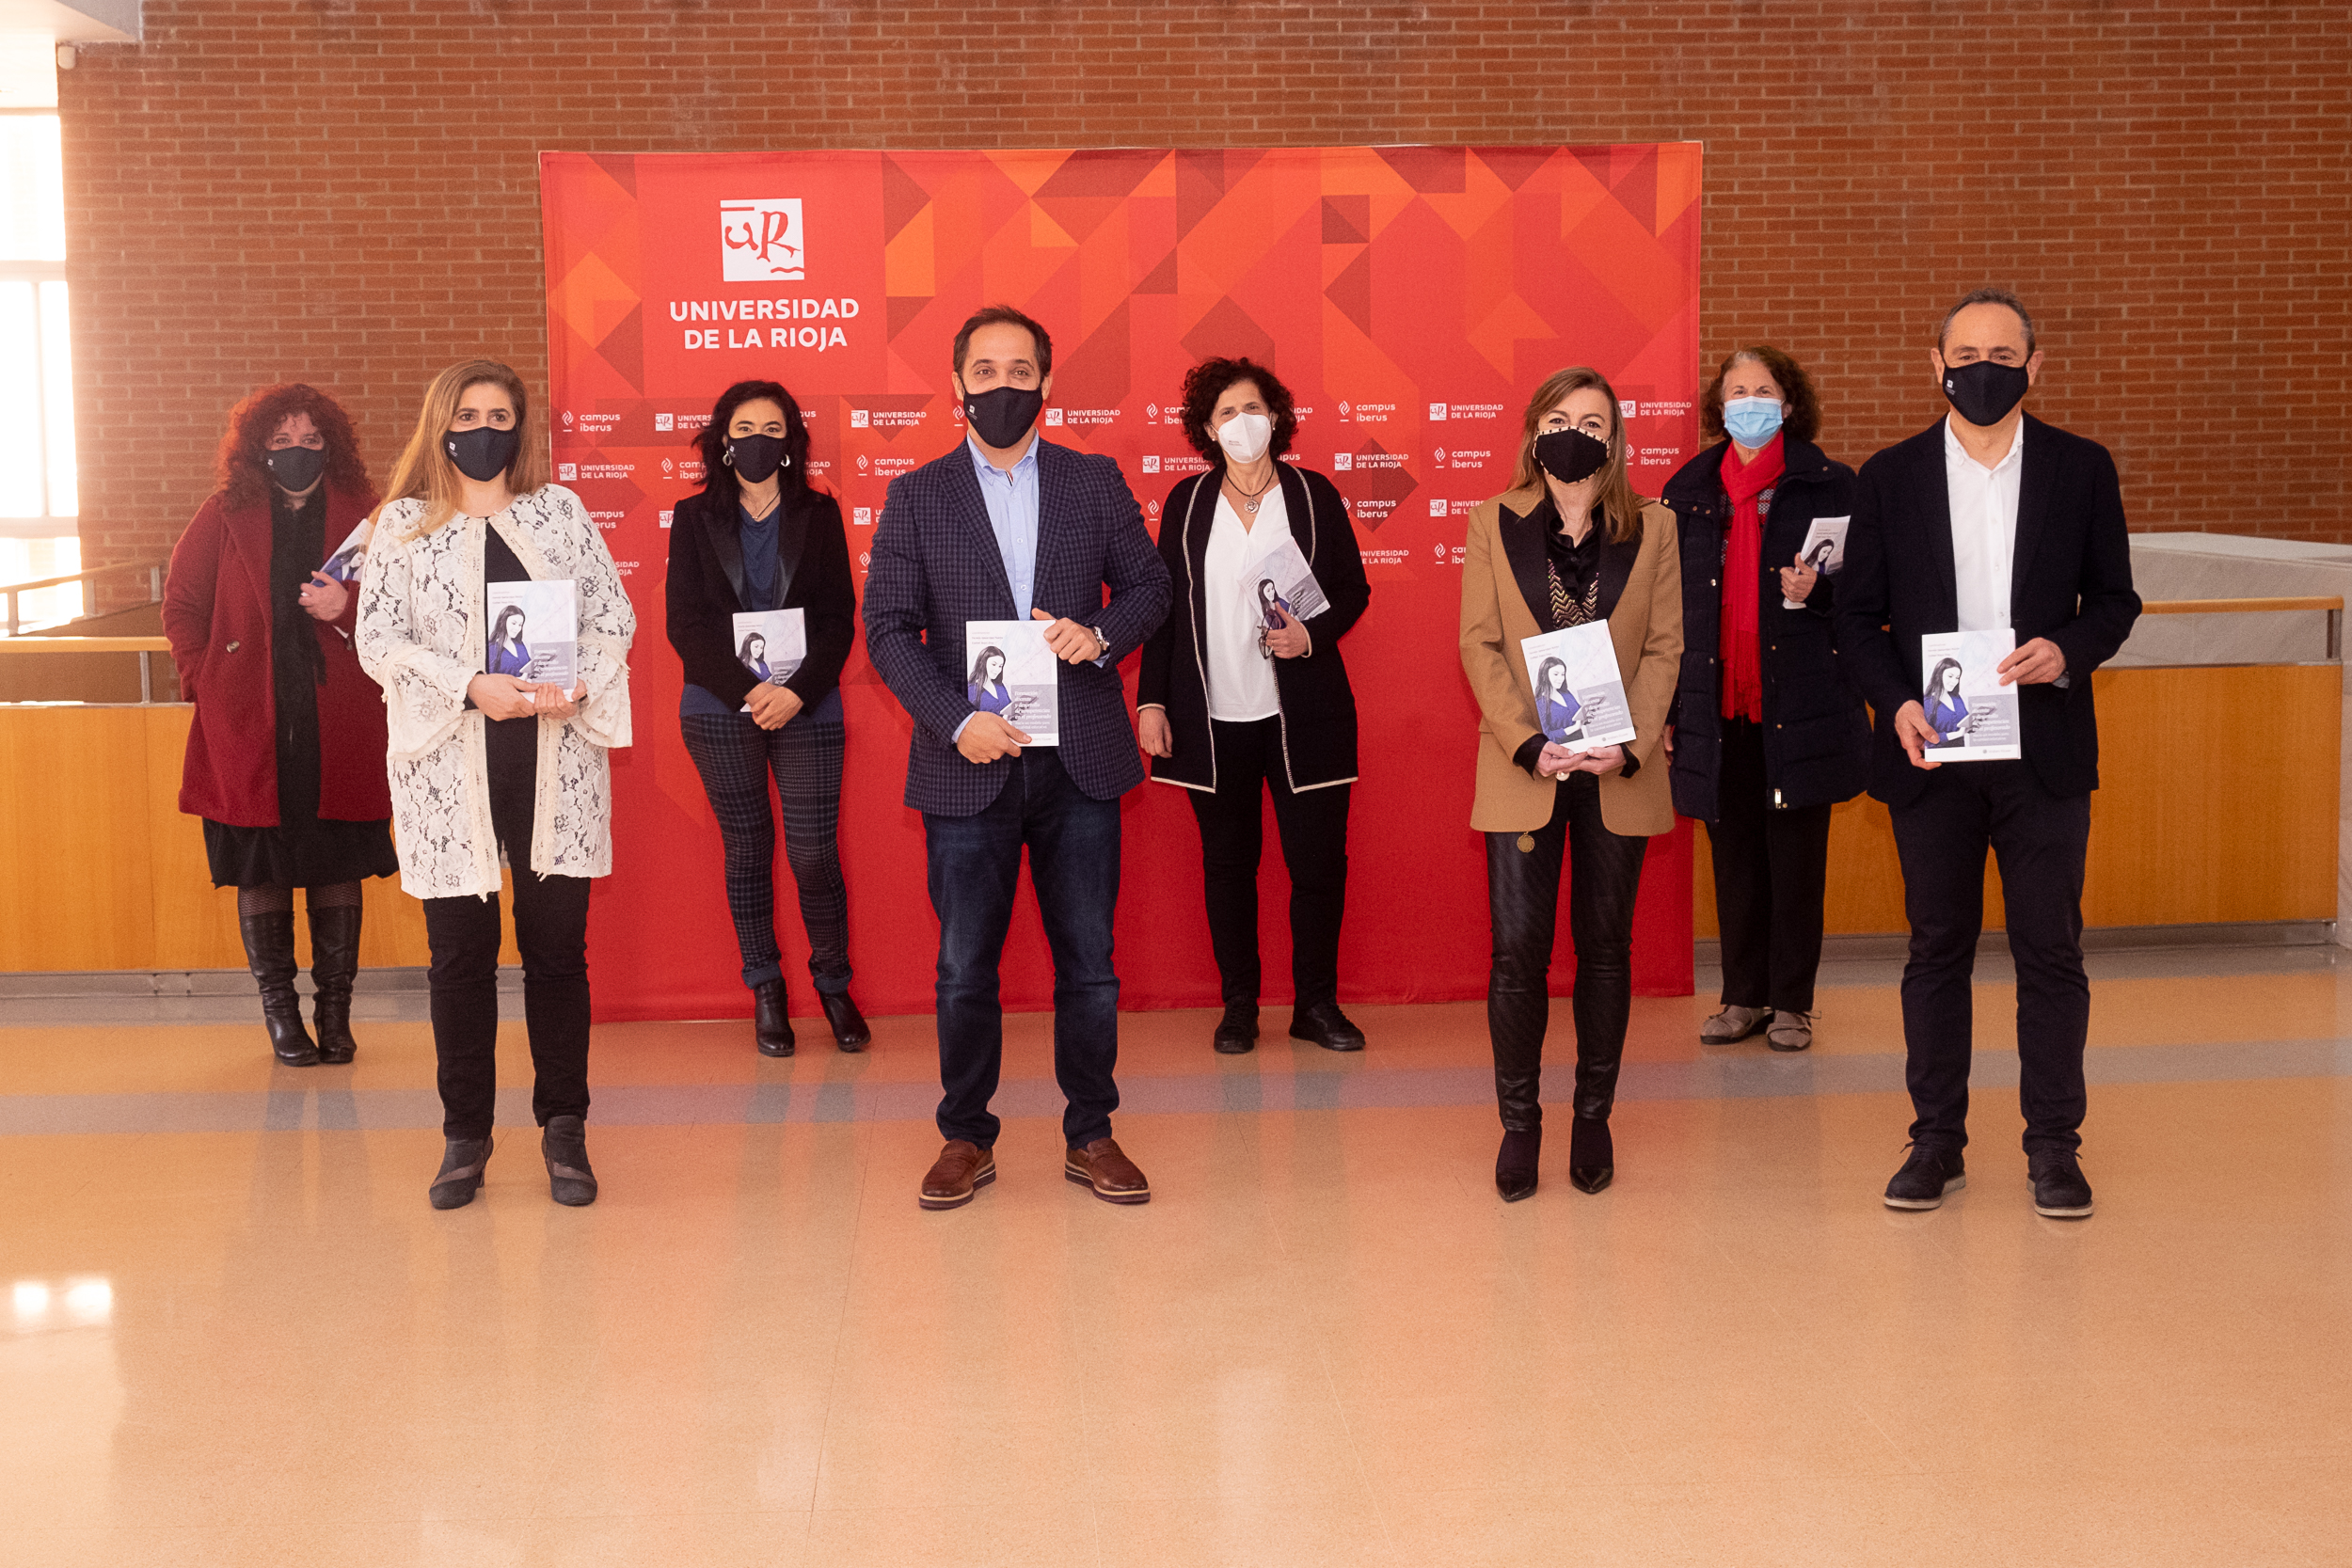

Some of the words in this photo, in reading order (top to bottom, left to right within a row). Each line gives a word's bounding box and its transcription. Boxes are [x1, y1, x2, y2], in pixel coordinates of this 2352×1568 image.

[670, 298, 859, 322] UNIVERSIDAD
[684, 329, 720, 350] DE
[728, 328, 763, 349] LA
[771, 326, 848, 353] RIOJA
[1356, 404, 1396, 413] campus
[1663, 408, 1685, 417] RIOJA
[580, 413, 621, 423] campus
[1357, 413, 1388, 422] iberus
[1474, 411, 1497, 420] RIOJA
[897, 419, 920, 427] RIOJA
[1091, 417, 1114, 425] RIOJA
[580, 422, 612, 432] iberus
[1452, 451, 1491, 460] campus
[1640, 448, 1679, 456] campus
[874, 458, 914, 467] campus
[1380, 461, 1402, 469] RIOJA
[1452, 459, 1483, 468] iberus
[1641, 456, 1671, 466] iberus
[1188, 464, 1211, 472] RIOJA
[605, 471, 628, 480] RIOJA
[1357, 499, 1396, 509] campus
[1357, 509, 1388, 518] iberus
[1380, 557, 1402, 565] RIOJA
